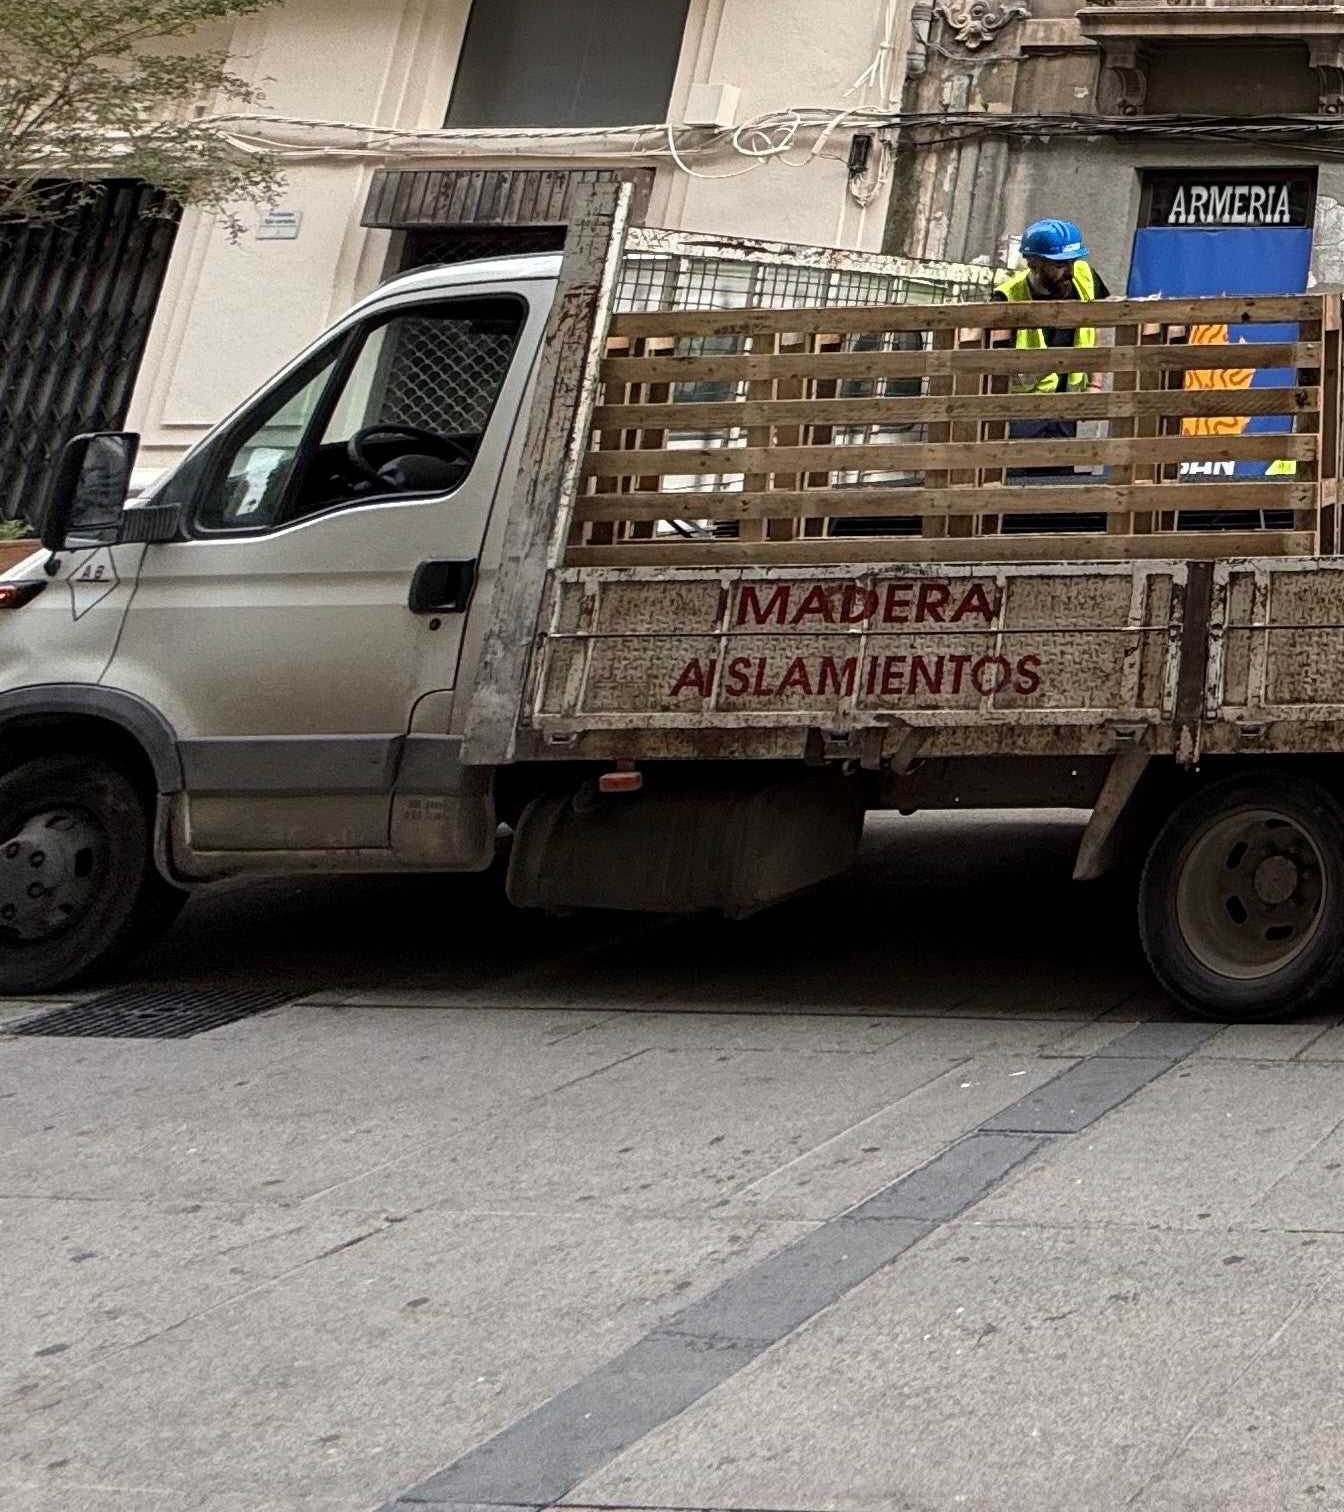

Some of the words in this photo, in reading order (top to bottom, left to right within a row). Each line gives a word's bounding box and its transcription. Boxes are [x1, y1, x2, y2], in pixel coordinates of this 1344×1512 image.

[1168, 185, 1291, 223] ARMERIA
[736, 583, 1000, 626] MADERA
[668, 654, 1042, 697] AISLAMIENTOS
